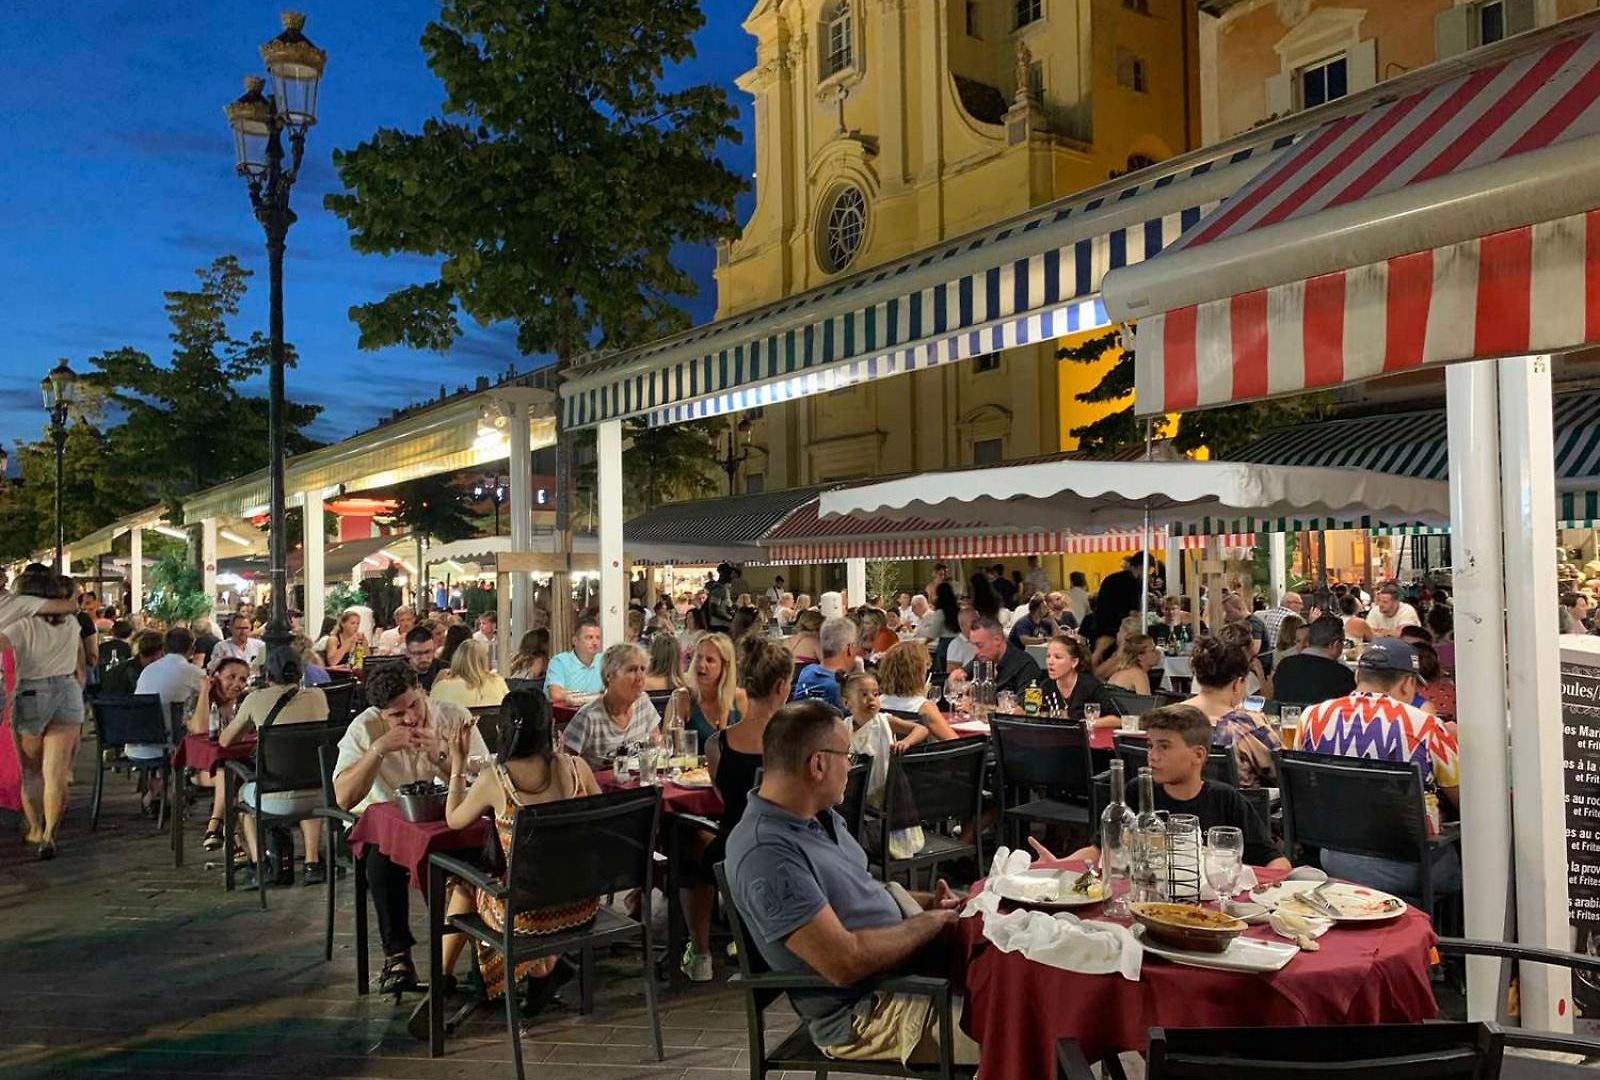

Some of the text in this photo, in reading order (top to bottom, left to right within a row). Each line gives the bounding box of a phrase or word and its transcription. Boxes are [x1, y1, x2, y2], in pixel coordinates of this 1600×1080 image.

[1561, 681, 1600, 701] oules/
[1586, 760, 1597, 771] la
[1572, 795, 1585, 804] au
[1579, 829, 1592, 839] au
[1571, 860, 1580, 873] la
[1574, 896, 1600, 910] arabi
